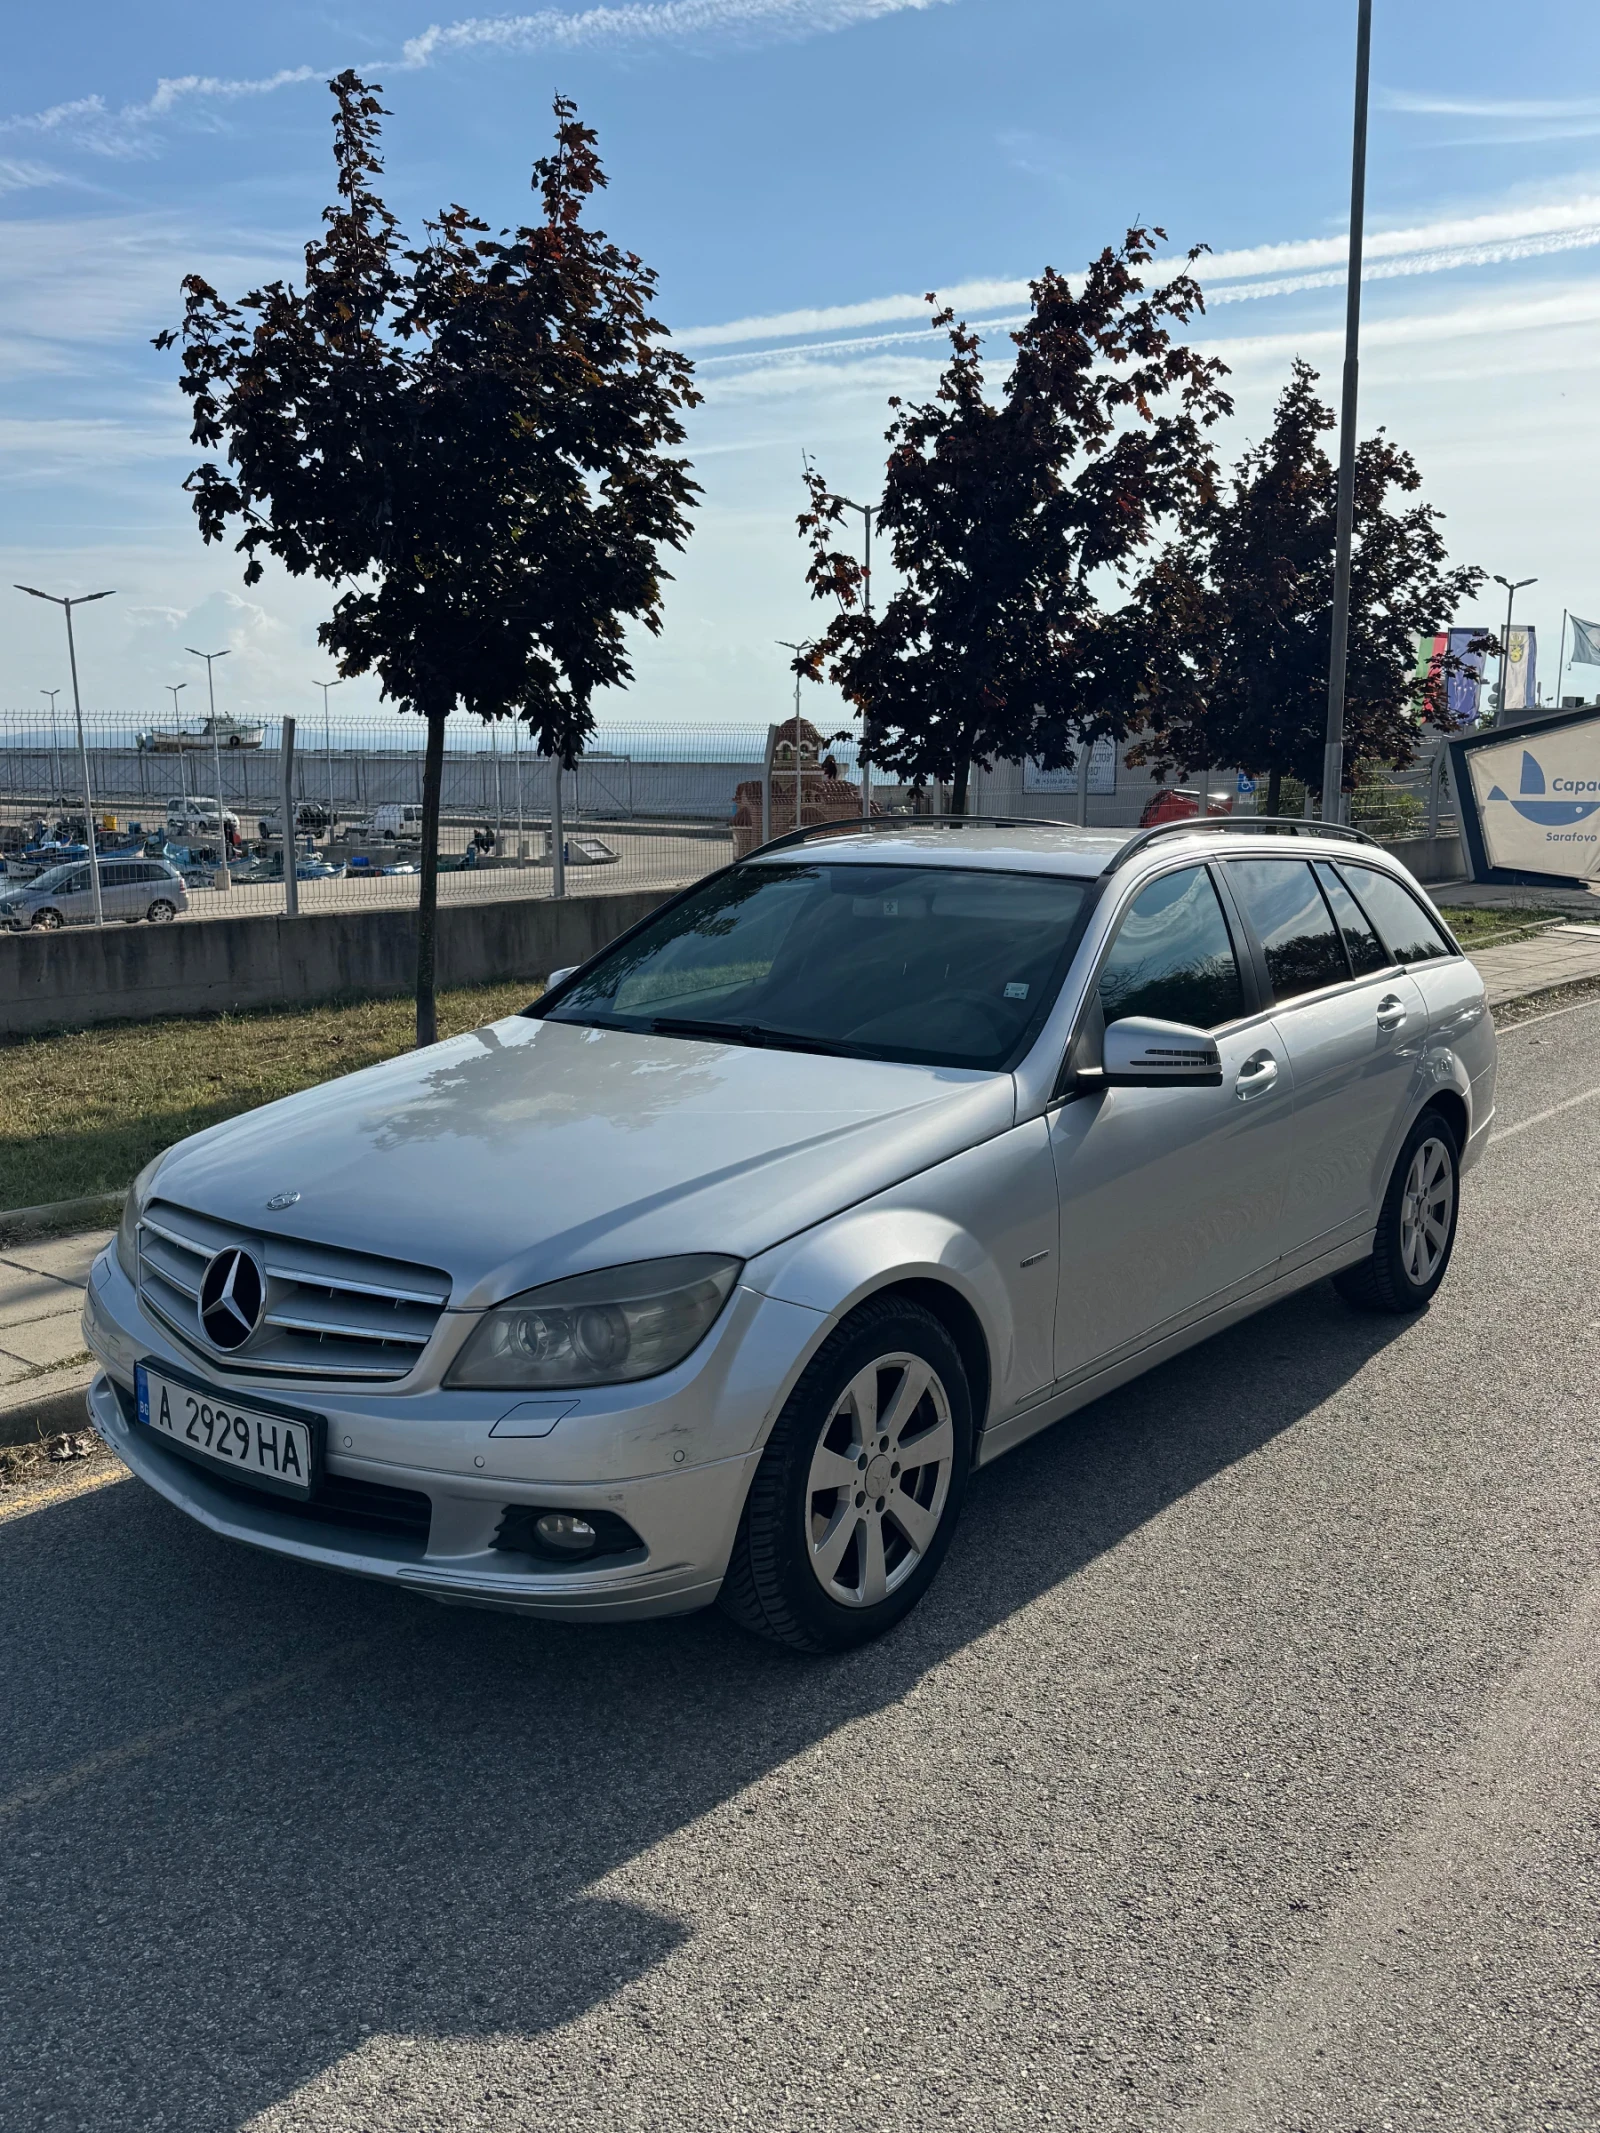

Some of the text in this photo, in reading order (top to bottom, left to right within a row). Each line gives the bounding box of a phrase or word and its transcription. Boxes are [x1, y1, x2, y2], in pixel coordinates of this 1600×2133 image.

[1552, 778, 1600, 795] Capa
[1546, 832, 1597, 842] Sarafovo
[139, 1400, 149, 1416] BG
[160, 1385, 301, 1477] A 2929 HA
